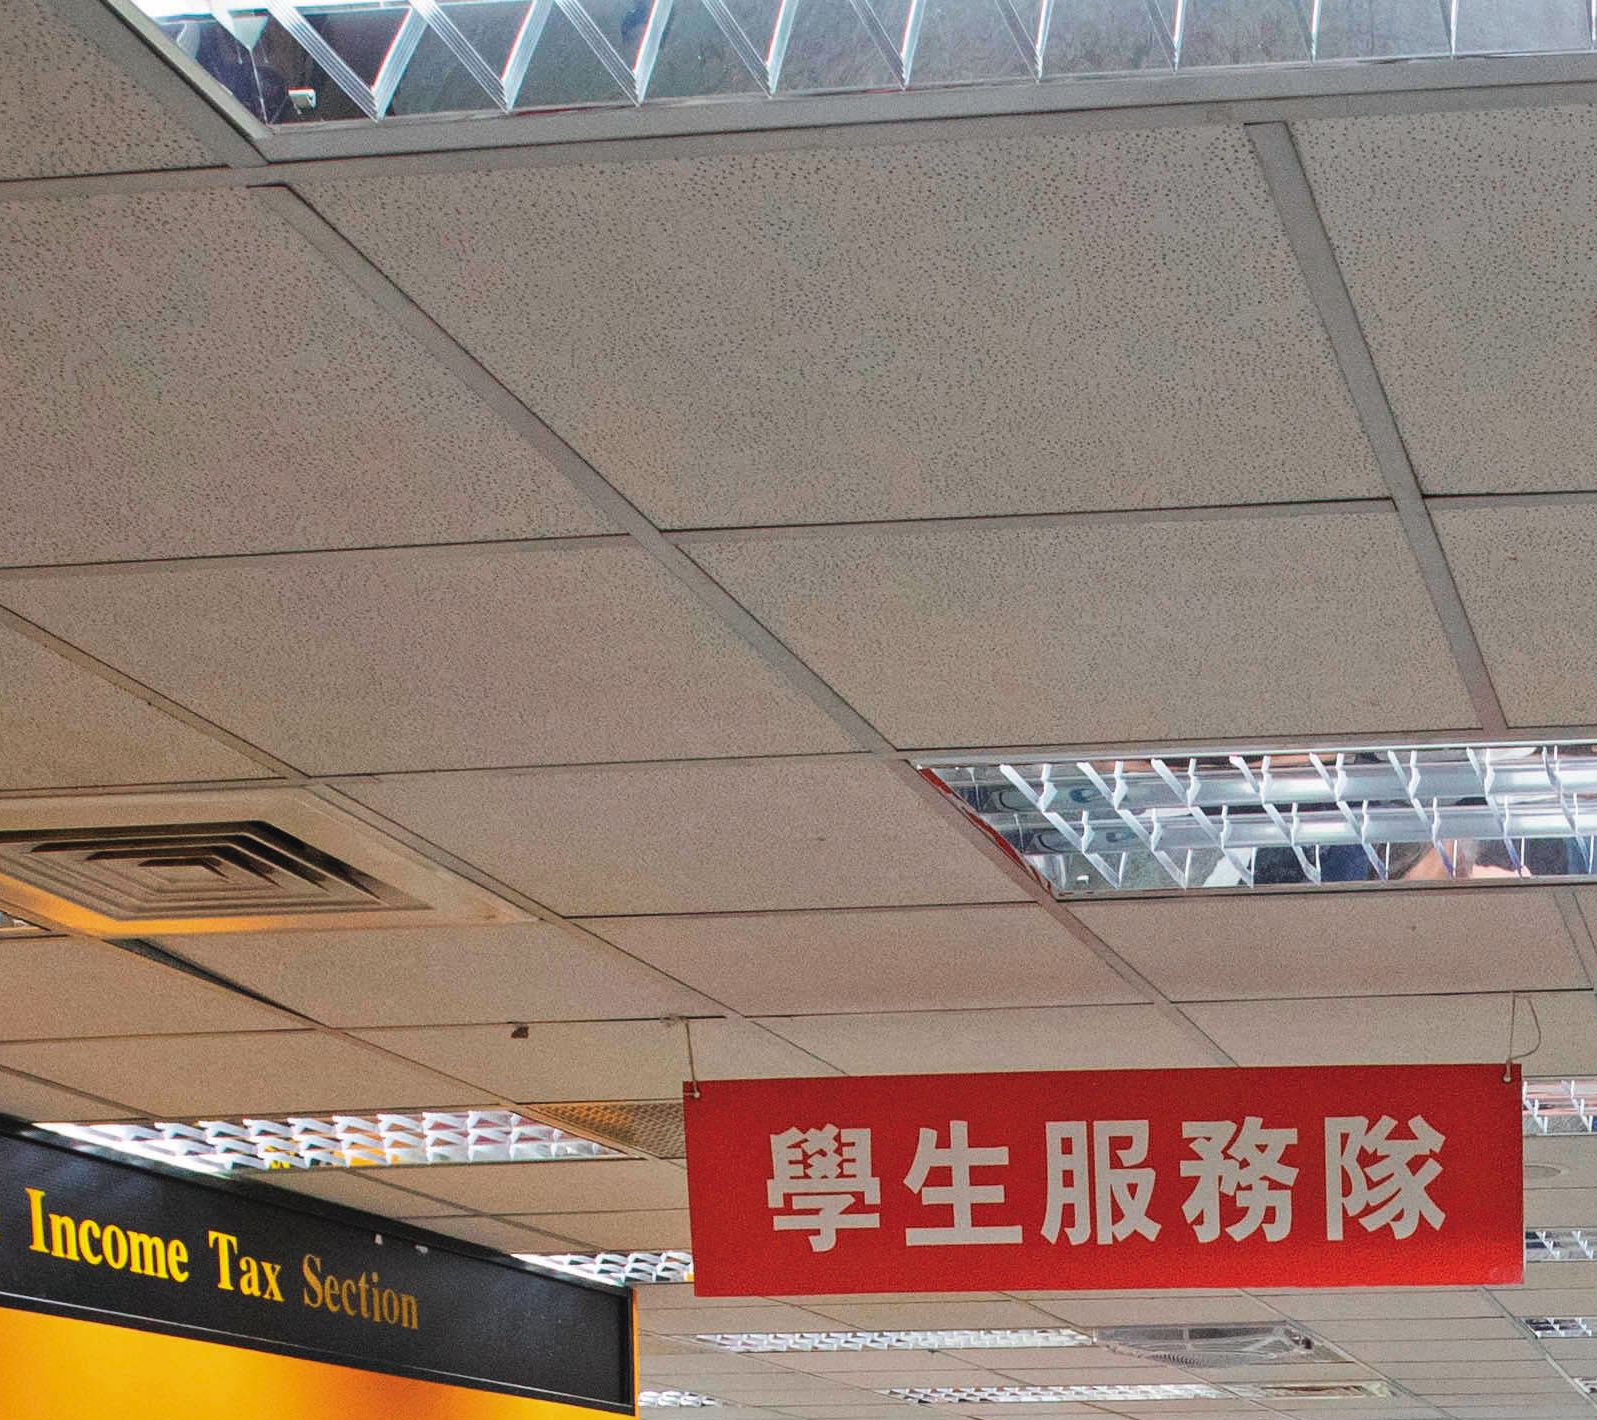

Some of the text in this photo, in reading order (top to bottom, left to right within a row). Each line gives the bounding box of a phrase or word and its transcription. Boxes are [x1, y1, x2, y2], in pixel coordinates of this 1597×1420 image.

[766, 1116, 1447, 1252] 學生服務隊
[27, 1189, 190, 1284] Income
[207, 1230, 284, 1303] Tax
[301, 1253, 420, 1331] Section
